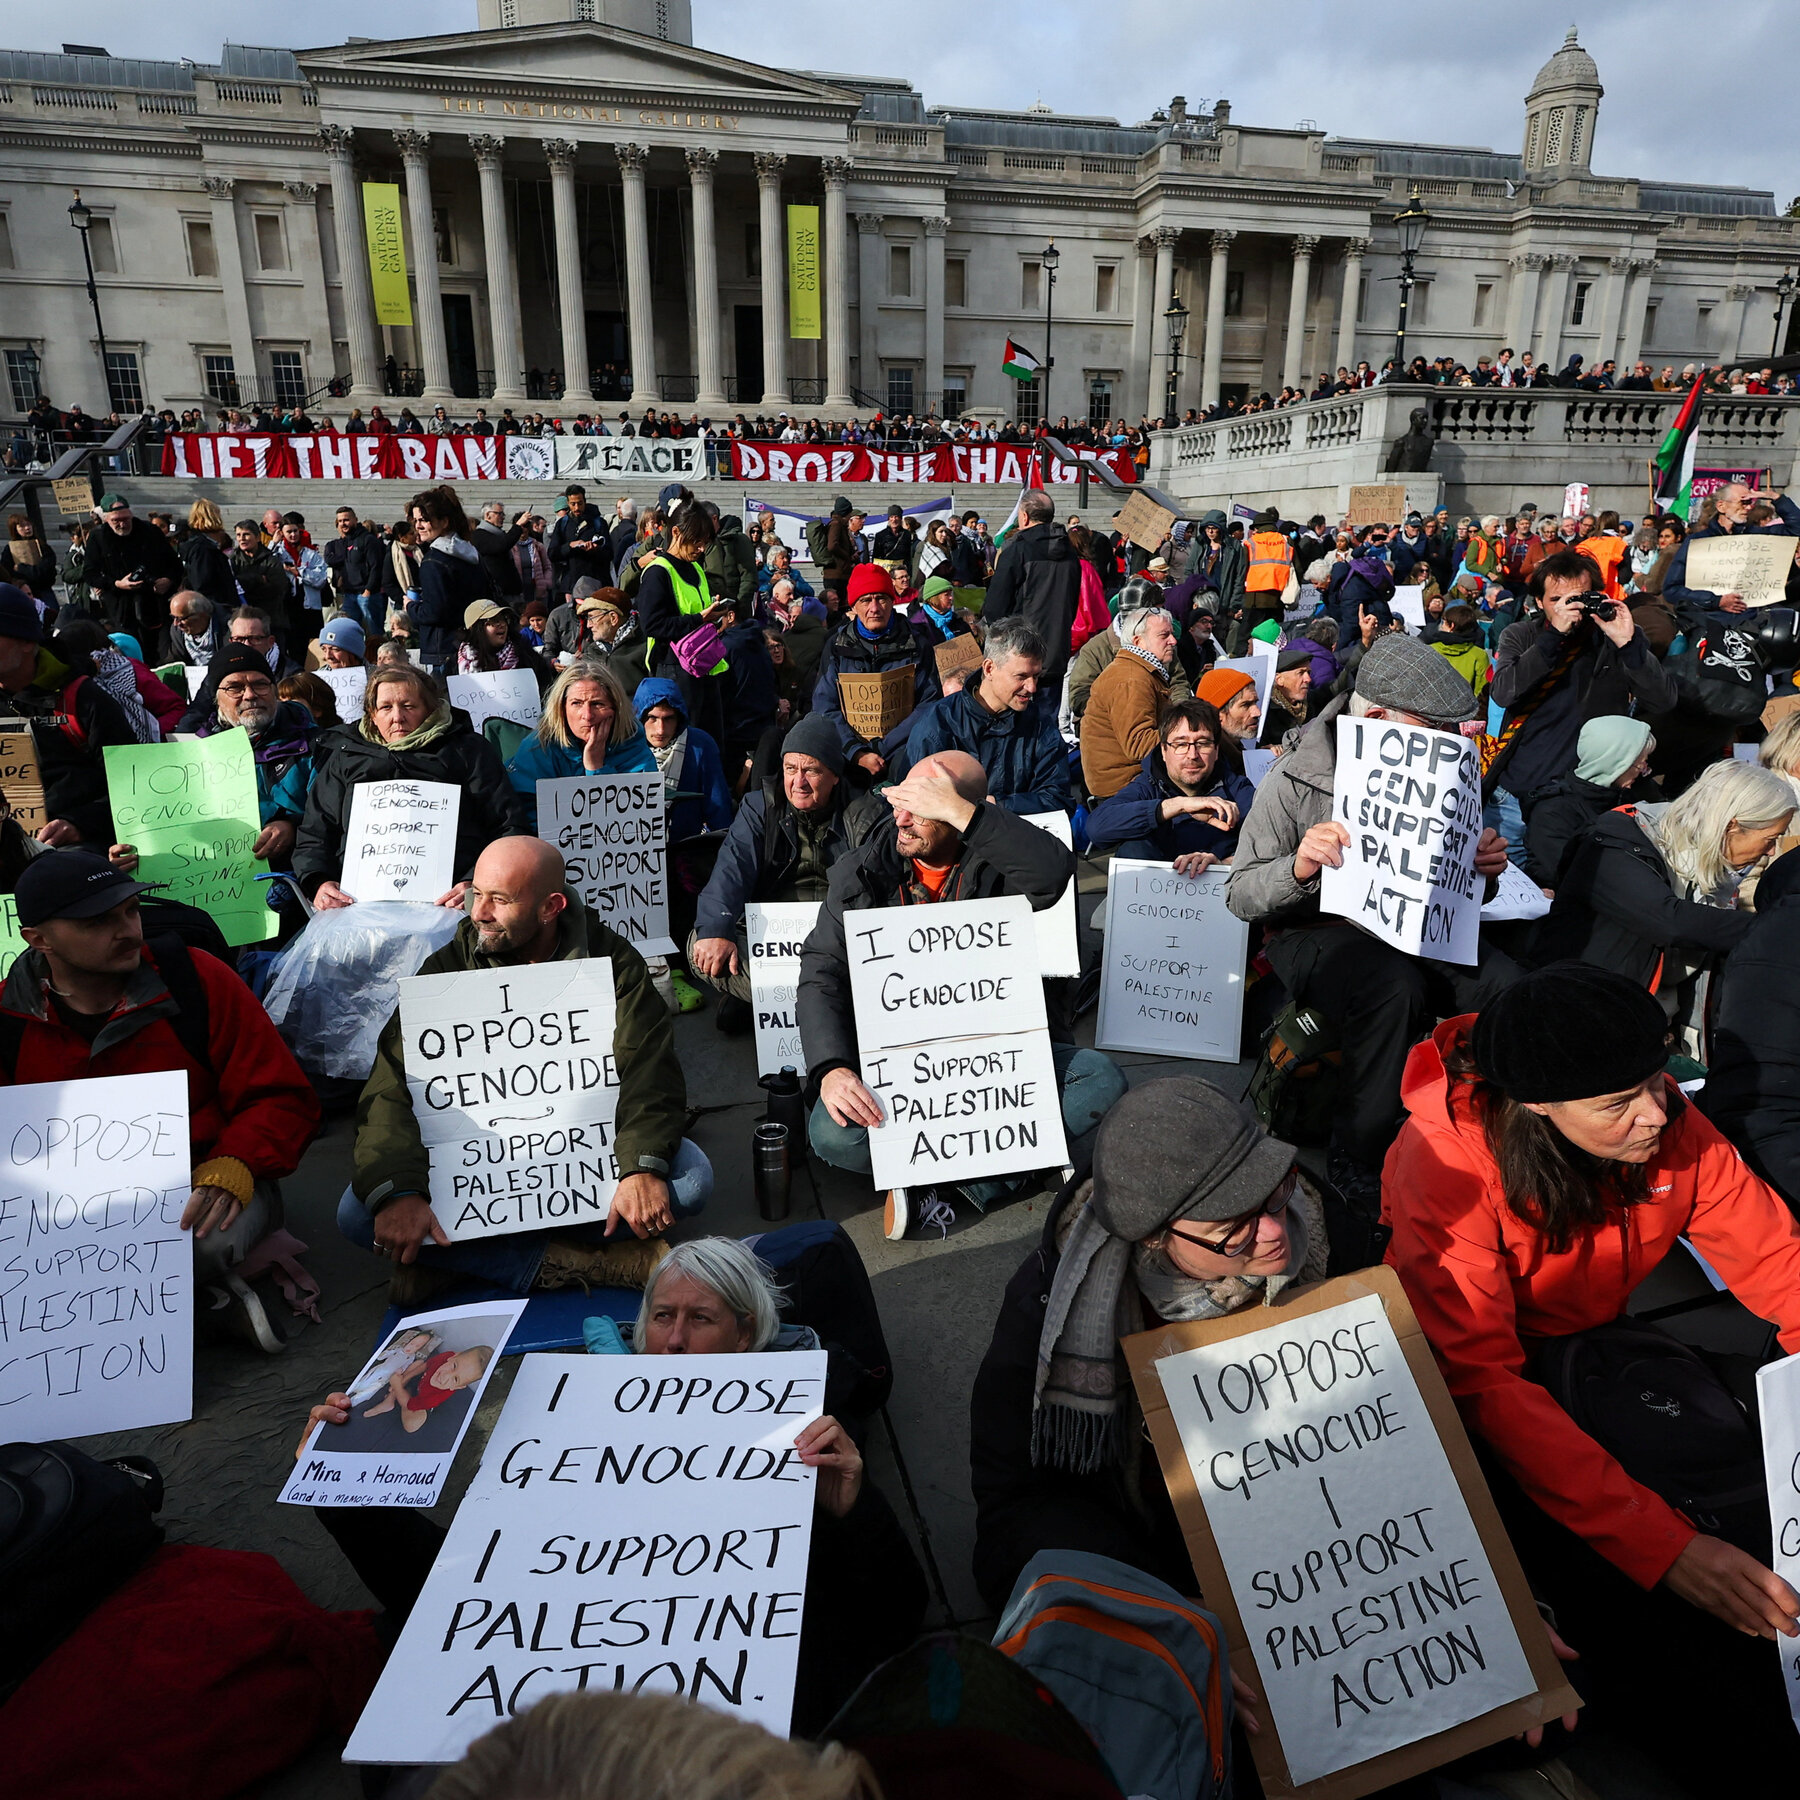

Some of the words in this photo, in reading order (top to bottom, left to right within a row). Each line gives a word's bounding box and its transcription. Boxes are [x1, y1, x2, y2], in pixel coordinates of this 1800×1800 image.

[440, 97, 487, 113] THE
[503, 102, 622, 122] NATIONAL
[639, 111, 741, 130] GALLERY
[374, 207, 389, 272] NATIONAL
[385, 207, 401, 273] GALLERY
[796, 229, 805, 290] NATIONAL
[805, 228, 816, 291] GALLERY
[172, 436, 271, 478] LIFT
[288, 436, 382, 479] THE
[397, 436, 500, 480] BAN
[575, 442, 693, 473] PEACE
[737, 442, 856, 482] DROP
[865, 448, 936, 482] THE
[1718, 540, 1771, 552] OPPOSE
[1711, 579, 1782, 590] PALESTINE
[1712, 569, 1770, 580] SUPPORT
[1740, 591, 1770, 600] TION
[456, 686, 522, 707] OPPOSE
[492, 673, 496, 682] I
[848, 683, 853, 700] I
[858, 682, 899, 701] OPPO
[1355, 724, 1364, 760] I
[132, 764, 136, 795] I
[149, 750, 253, 795] OPPOSE
[116, 792, 251, 826] GENOCIDE
[370, 798, 448, 811] GENOCIDE!!
[555, 791, 559, 821] I
[571, 782, 661, 818] OPPOSE
[558, 816, 664, 850] GENOCIDE
[1358, 798, 1468, 862] SUPPORT
[361, 843, 426, 859] PALESTINE
[376, 864, 419, 877] ACTION
[565, 848, 666, 885] SUPPORT
[1361, 834, 1477, 901] PALESTINE
[186, 881, 244, 907] TION
[585, 880, 664, 912] ESTINE
[1135, 877, 1139, 894] I
[1150, 878, 1225, 897] OPPOSE
[1127, 903, 1204, 922] GENOCIDE
[1363, 879, 1456, 944] ACTION
[752, 942, 803, 958] GENO
[856, 926, 895, 964] I
[908, 920, 1013, 954] OPPOSE
[1165, 935, 1181, 948] I
[499, 984, 513, 1014] I
[881, 972, 1013, 1012] GENOCIDE
[1125, 978, 1213, 1004] PALESTINE
[419, 1009, 590, 1060] OPPOSE
[1137, 1004, 1199, 1026] ACTION
[425, 1054, 621, 1110] GENOCIDE
[867, 1057, 893, 1090] I
[914, 1049, 1023, 1084] SUPPORT
[891, 1081, 1037, 1123] PALESTINE
[10, 1112, 184, 1170] OPPOSE
[463, 1121, 612, 1166] SUPPORT
[910, 1120, 1038, 1166] ACTION
[453, 1153, 620, 1198] PALESTINE
[0, 1184, 192, 1247] ENOCIDE
[455, 1185, 600, 1230] ACTION
[1, 1238, 183, 1297] SUPPORT
[1193, 1373, 1214, 1423] I
[1217, 1320, 1384, 1415] OPPOSE
[547, 1373, 570, 1412] I
[614, 1376, 821, 1415] OPPOSE
[1210, 1393, 1407, 1501] GENOCIDE
[301, 1460, 341, 1482] Mira
[372, 1462, 441, 1486] Hamoud
[287, 1483, 316, 1502] (and
[318, 1491, 328, 1503] in
[379, 1491, 392, 1503] of
[394, 1490, 436, 1506] Khaled)
[1319, 1476, 1342, 1529] I
[473, 1528, 501, 1583] I
[529, 1524, 802, 1577] SUPPORT
[1251, 1507, 1434, 1610] SUPPORT
[441, 1591, 802, 1652] PALESTINE
[1266, 1559, 1482, 1671] PALESTINE
[1331, 1624, 1486, 1728] ACTION
